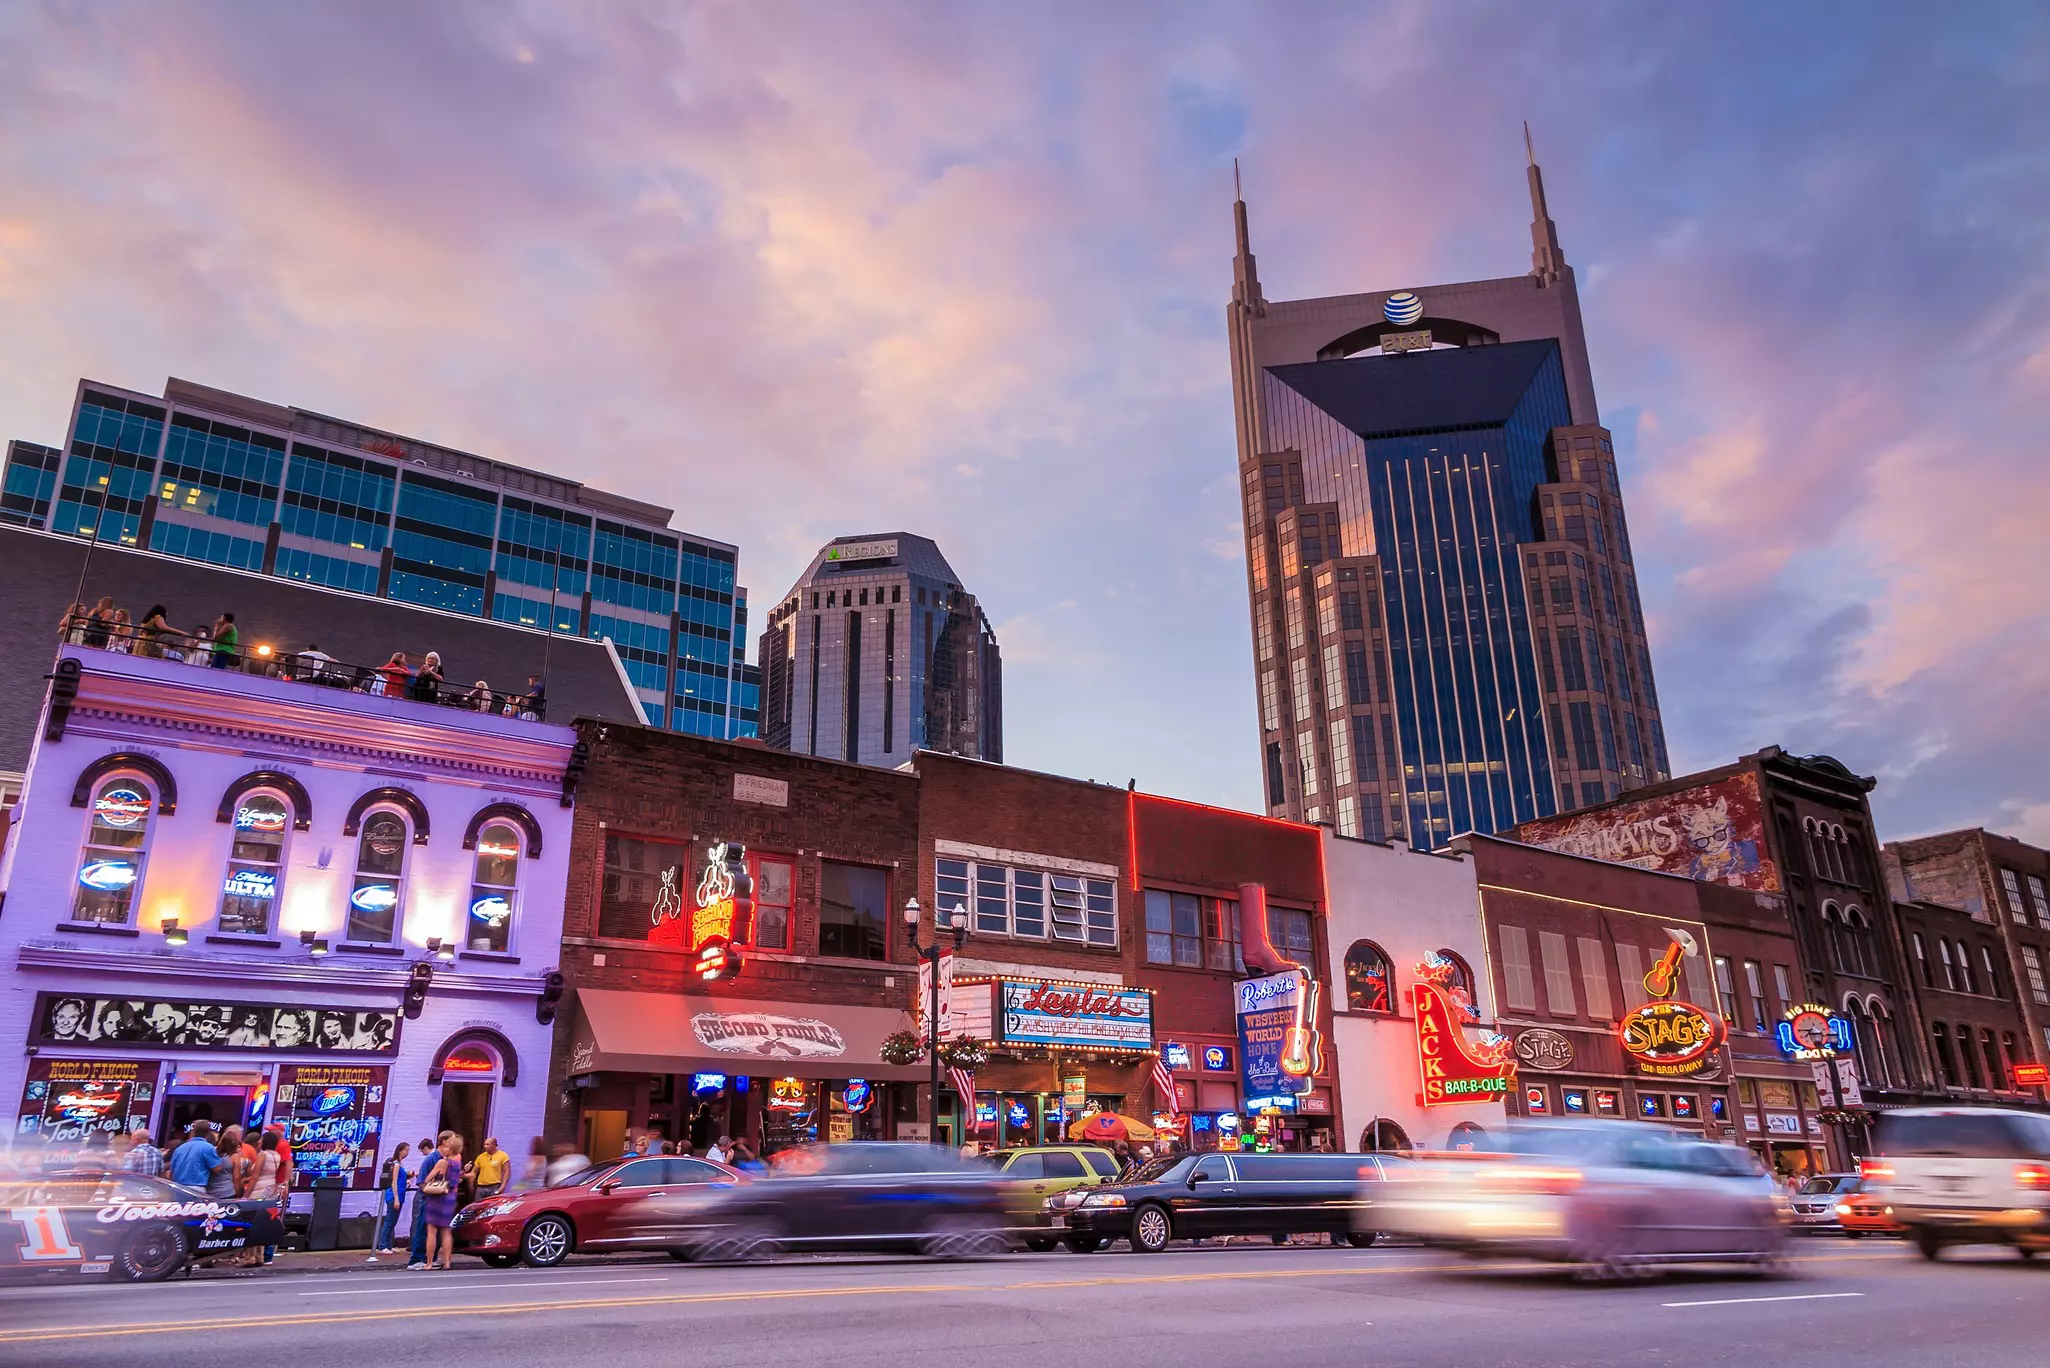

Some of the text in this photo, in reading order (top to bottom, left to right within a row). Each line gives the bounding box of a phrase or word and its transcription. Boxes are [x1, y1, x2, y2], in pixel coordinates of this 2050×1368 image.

[842, 544, 896, 559] REGIONS
[364, 832, 405, 842] Budweiser
[224, 880, 275, 896] ULTRA
[692, 899, 733, 932] SECOND
[692, 919, 731, 952] FIDDLE
[1023, 982, 1145, 1018] Layla's
[1240, 977, 1297, 1011] Robert's
[1653, 1004, 1672, 1015] THE
[1785, 1003, 1832, 1020] BIG TIME
[1245, 1010, 1294, 1029] WESTERN
[698, 1019, 841, 1050] SECOND FIDDLE
[1246, 1026, 1283, 1043] WORLD
[1624, 1013, 1711, 1053] STAGE
[573, 1041, 595, 1058] Second
[1248, 1042, 1277, 1057] HOME
[1419, 991, 1447, 1100] JACKS
[1519, 1033, 1572, 1059] STAGE
[49, 1062, 139, 1079] WORLD FAMOUS
[445, 1058, 492, 1069] Budweiser
[572, 1058, 593, 1072] Fiddle
[1640, 1059, 1704, 1074] ON BROADWAY
[296, 1068, 371, 1084] WORLD FAMOUS
[1445, 1078, 1507, 1094] BAR-B-QUE
[771, 1097, 805, 1107] Budweiser
[1260, 1105, 1281, 1115] GRILL
[44, 1115, 122, 1144] Tootsies
[290, 1116, 358, 1141] Tootsies
[1241, 1134, 1255, 1144] ATM
[96, 1196, 227, 1224] Tootsies
[198, 1237, 245, 1249] Barber Oil
